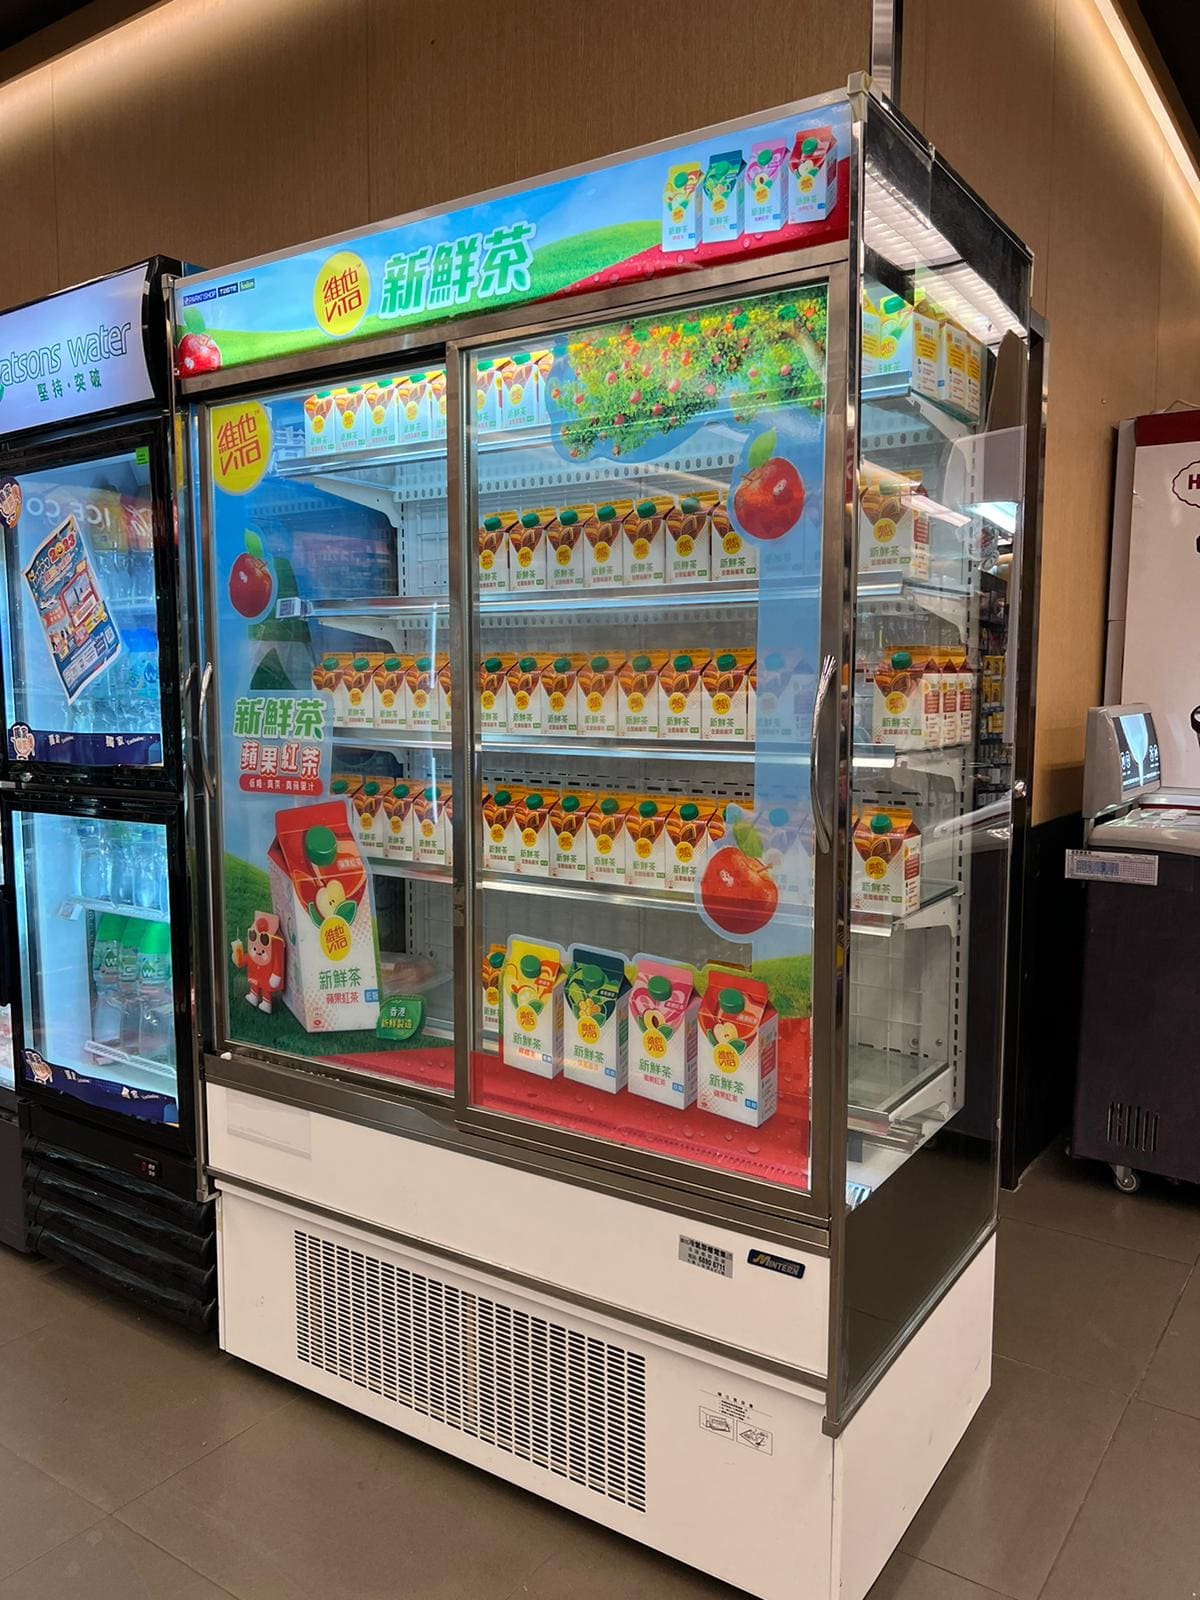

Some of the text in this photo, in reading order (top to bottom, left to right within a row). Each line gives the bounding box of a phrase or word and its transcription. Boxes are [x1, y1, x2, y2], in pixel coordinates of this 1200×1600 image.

[323, 268, 358, 304] 維他
[380, 223, 533, 315] 新鮮茶
[67, 322, 131, 367] water
[216, 412, 257, 454] 維他
[233, 698, 326, 741] 新鮮茶
[240, 741, 321, 778] 蘋果紅茶
[318, 967, 362, 991] 新鮮茶
[512, 1032, 542, 1051] 新鮮茶
[574, 1044, 605, 1064] 新鮮茶
[638, 1058, 672, 1080] 新鮮茶
[708, 1073, 745, 1095] 新鮮茶
